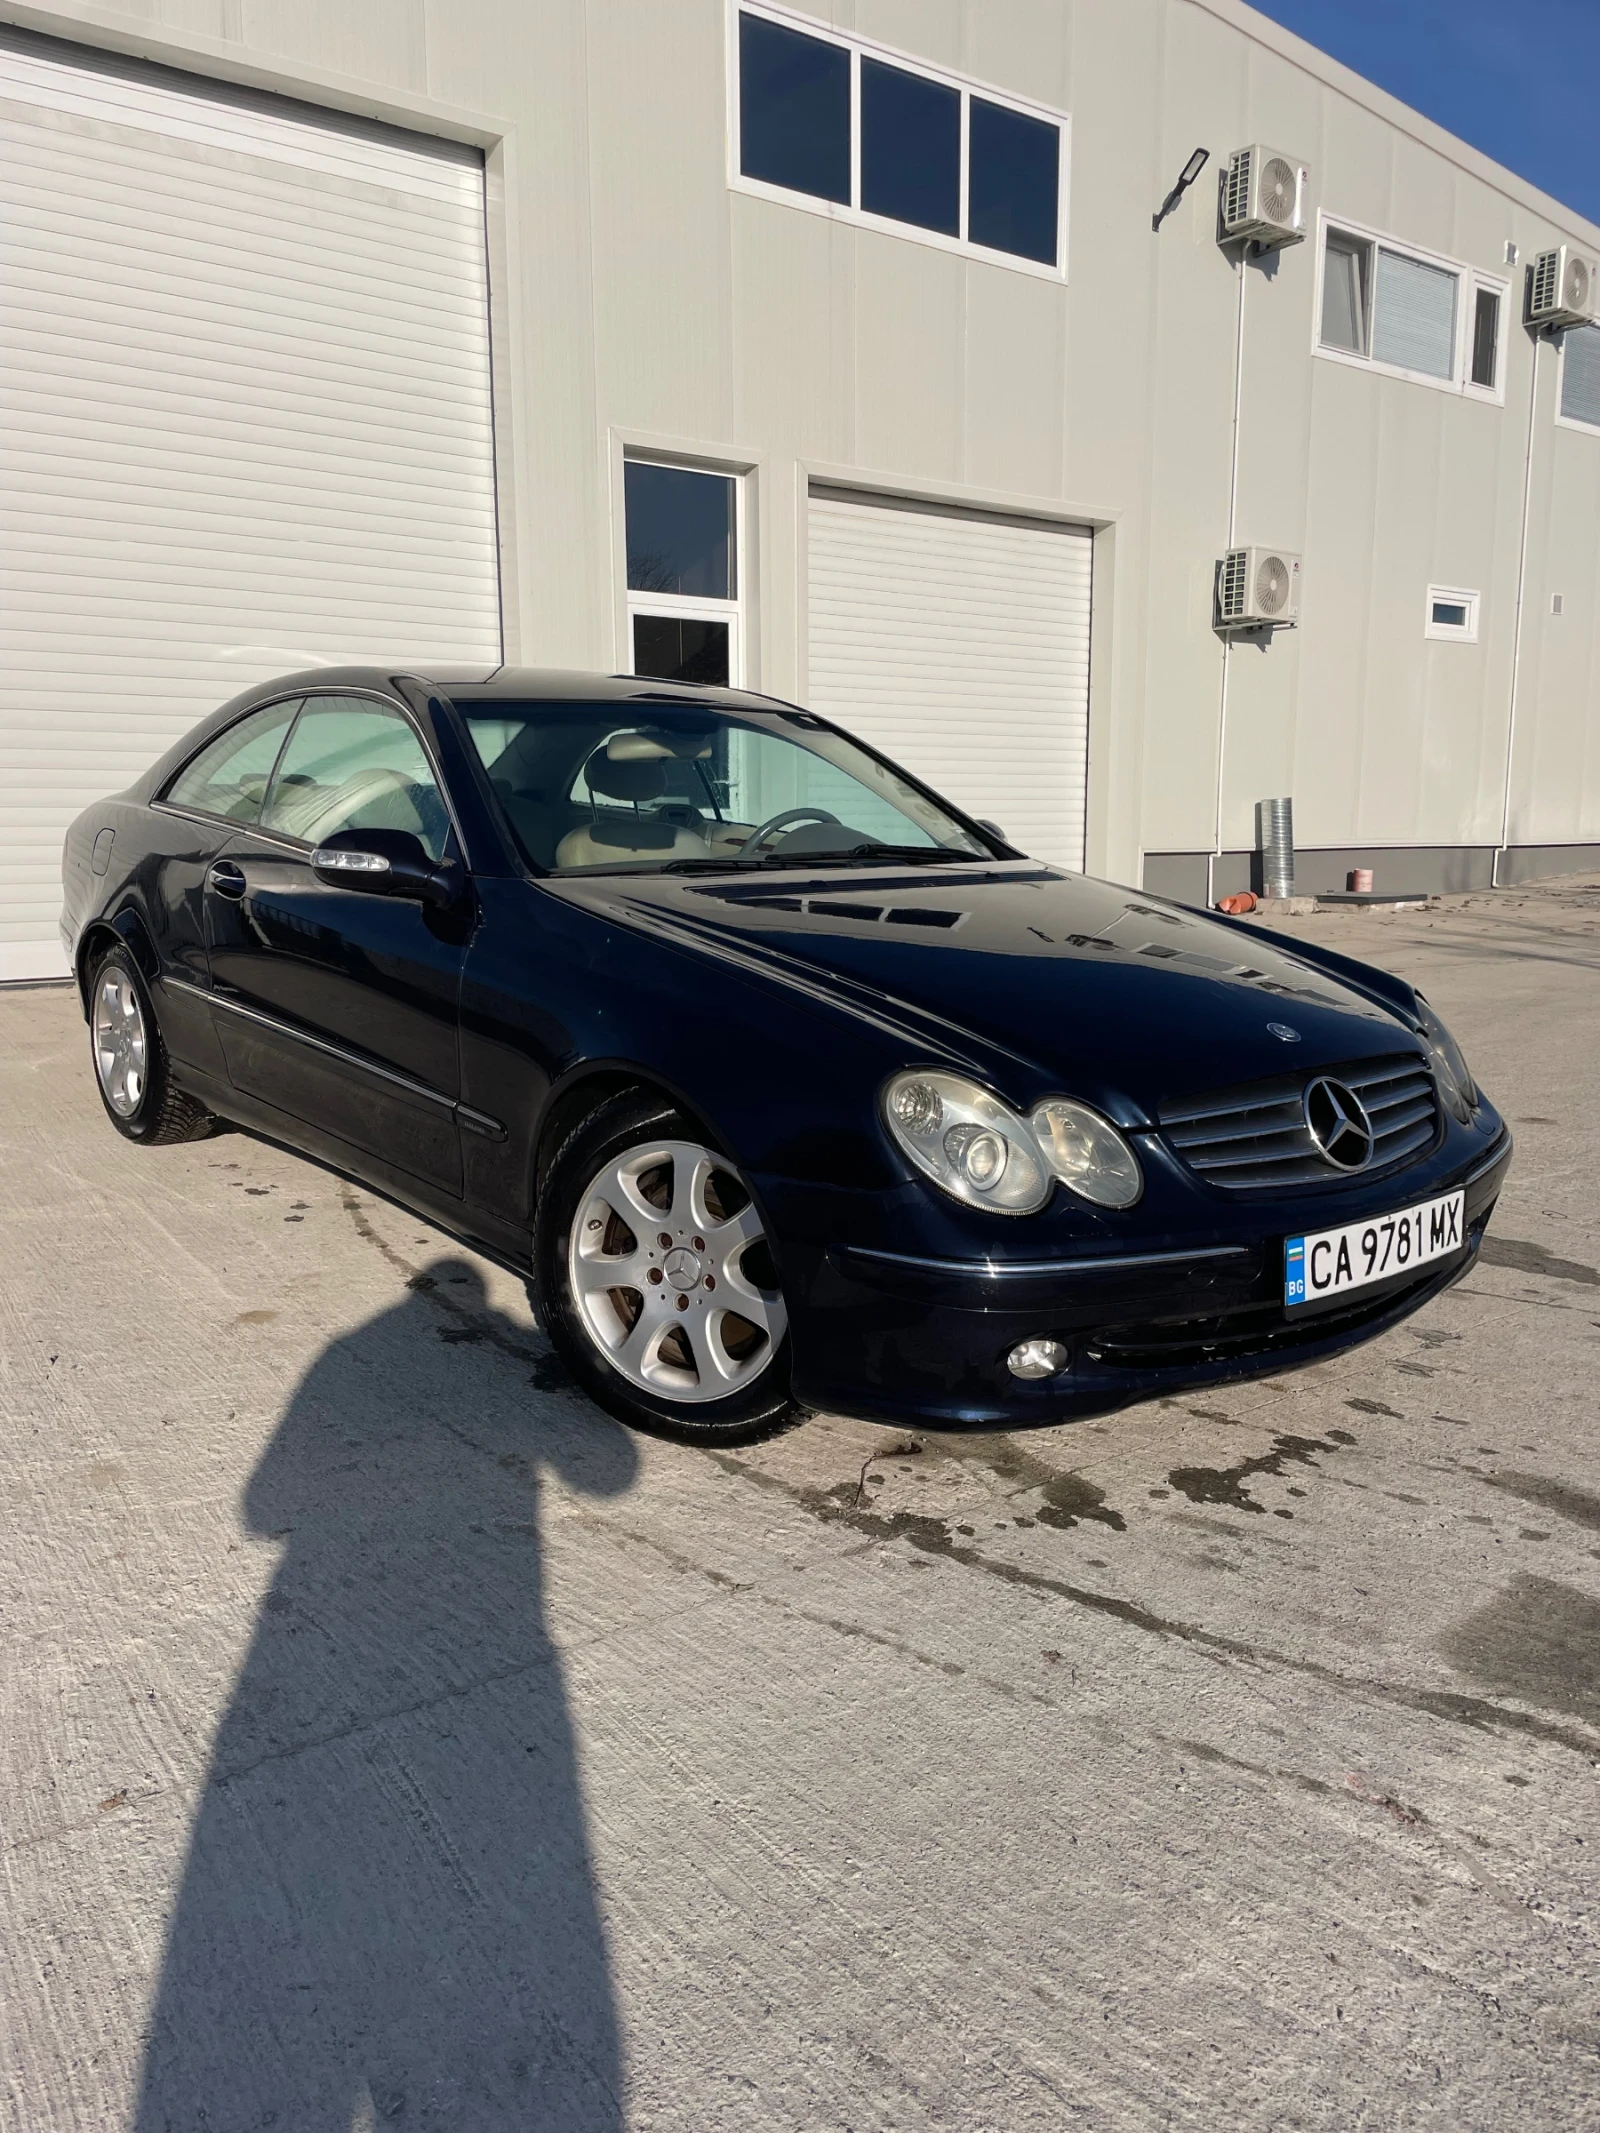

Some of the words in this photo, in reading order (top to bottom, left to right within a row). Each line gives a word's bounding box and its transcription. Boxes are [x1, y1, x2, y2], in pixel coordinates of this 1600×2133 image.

[1311, 1235, 1353, 1289] CA
[1361, 1211, 1422, 1276] 9781
[1430, 1197, 1460, 1252] MX
[1288, 1279, 1304, 1296] BG
